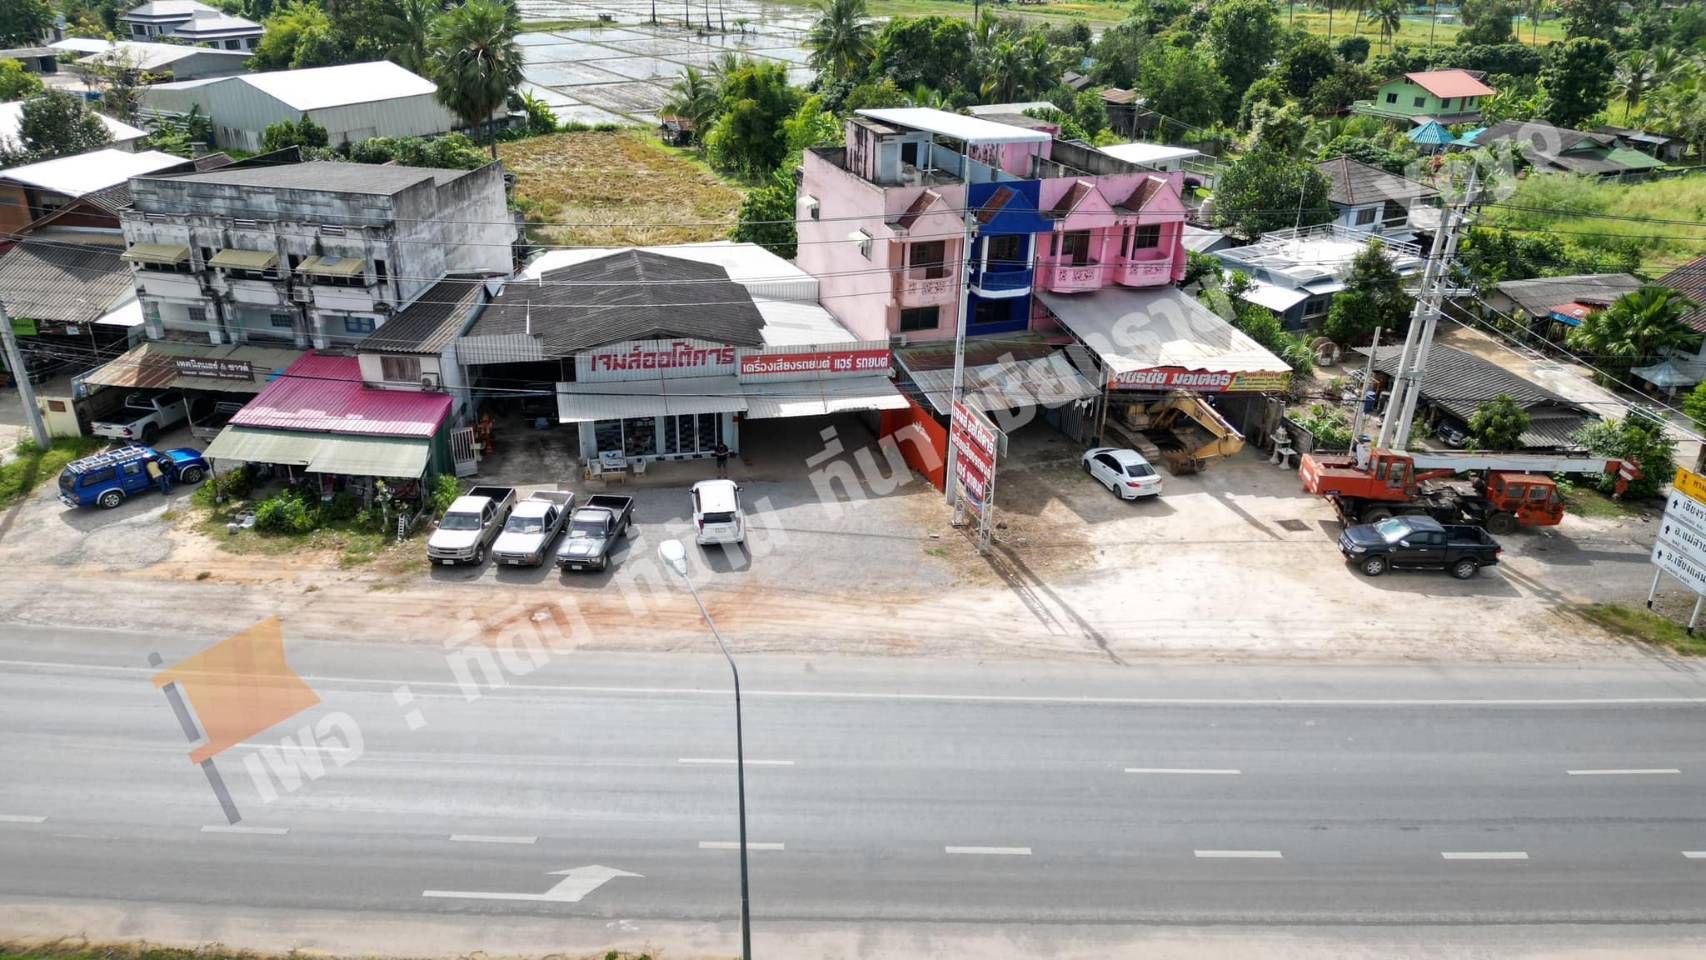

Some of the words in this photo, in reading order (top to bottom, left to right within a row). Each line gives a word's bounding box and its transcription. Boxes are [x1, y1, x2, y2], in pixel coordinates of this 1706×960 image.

[743, 355, 831, 373] เครื่องเสียงรถยนต์
[834, 354, 854, 369] แอร์
[856, 352, 889, 368] รถยนต์
